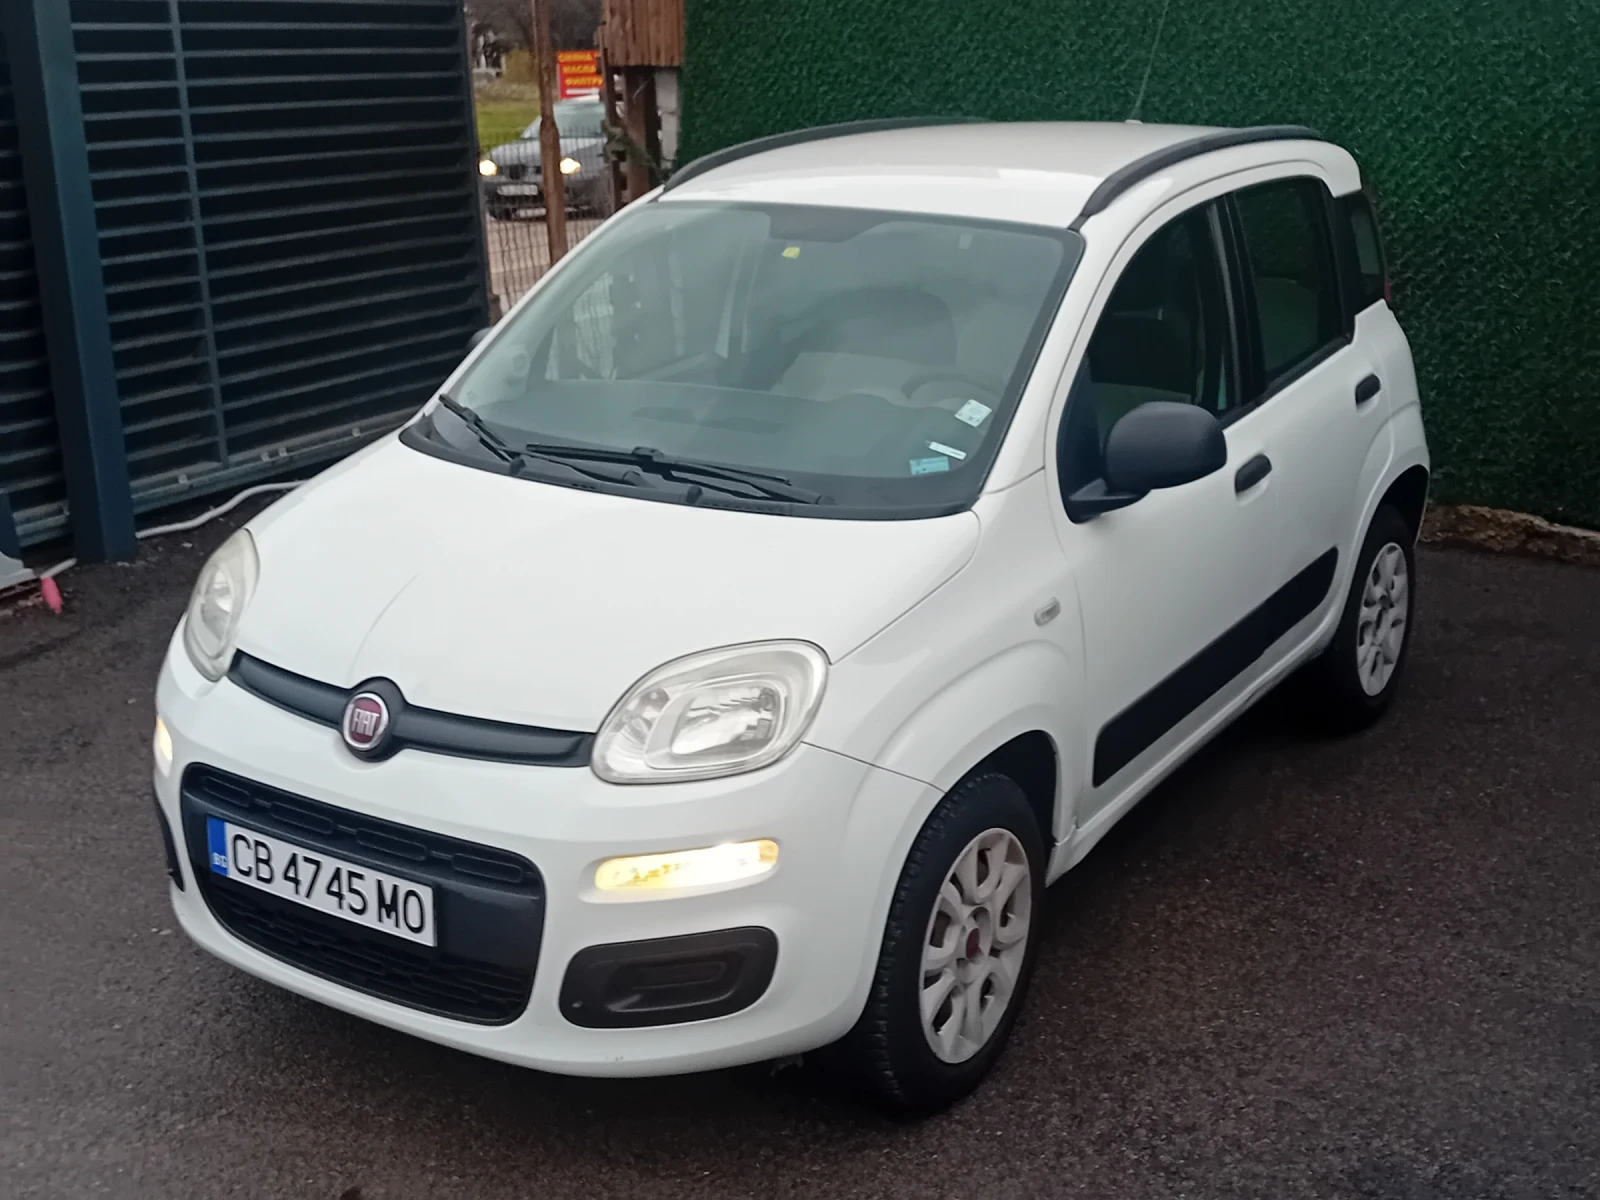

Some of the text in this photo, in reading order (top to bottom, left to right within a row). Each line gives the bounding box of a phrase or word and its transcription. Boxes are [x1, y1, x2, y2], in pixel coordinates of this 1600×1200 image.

[352, 707, 380, 737] FIAT
[233, 834, 275, 884] CB
[283, 852, 369, 915] 4745
